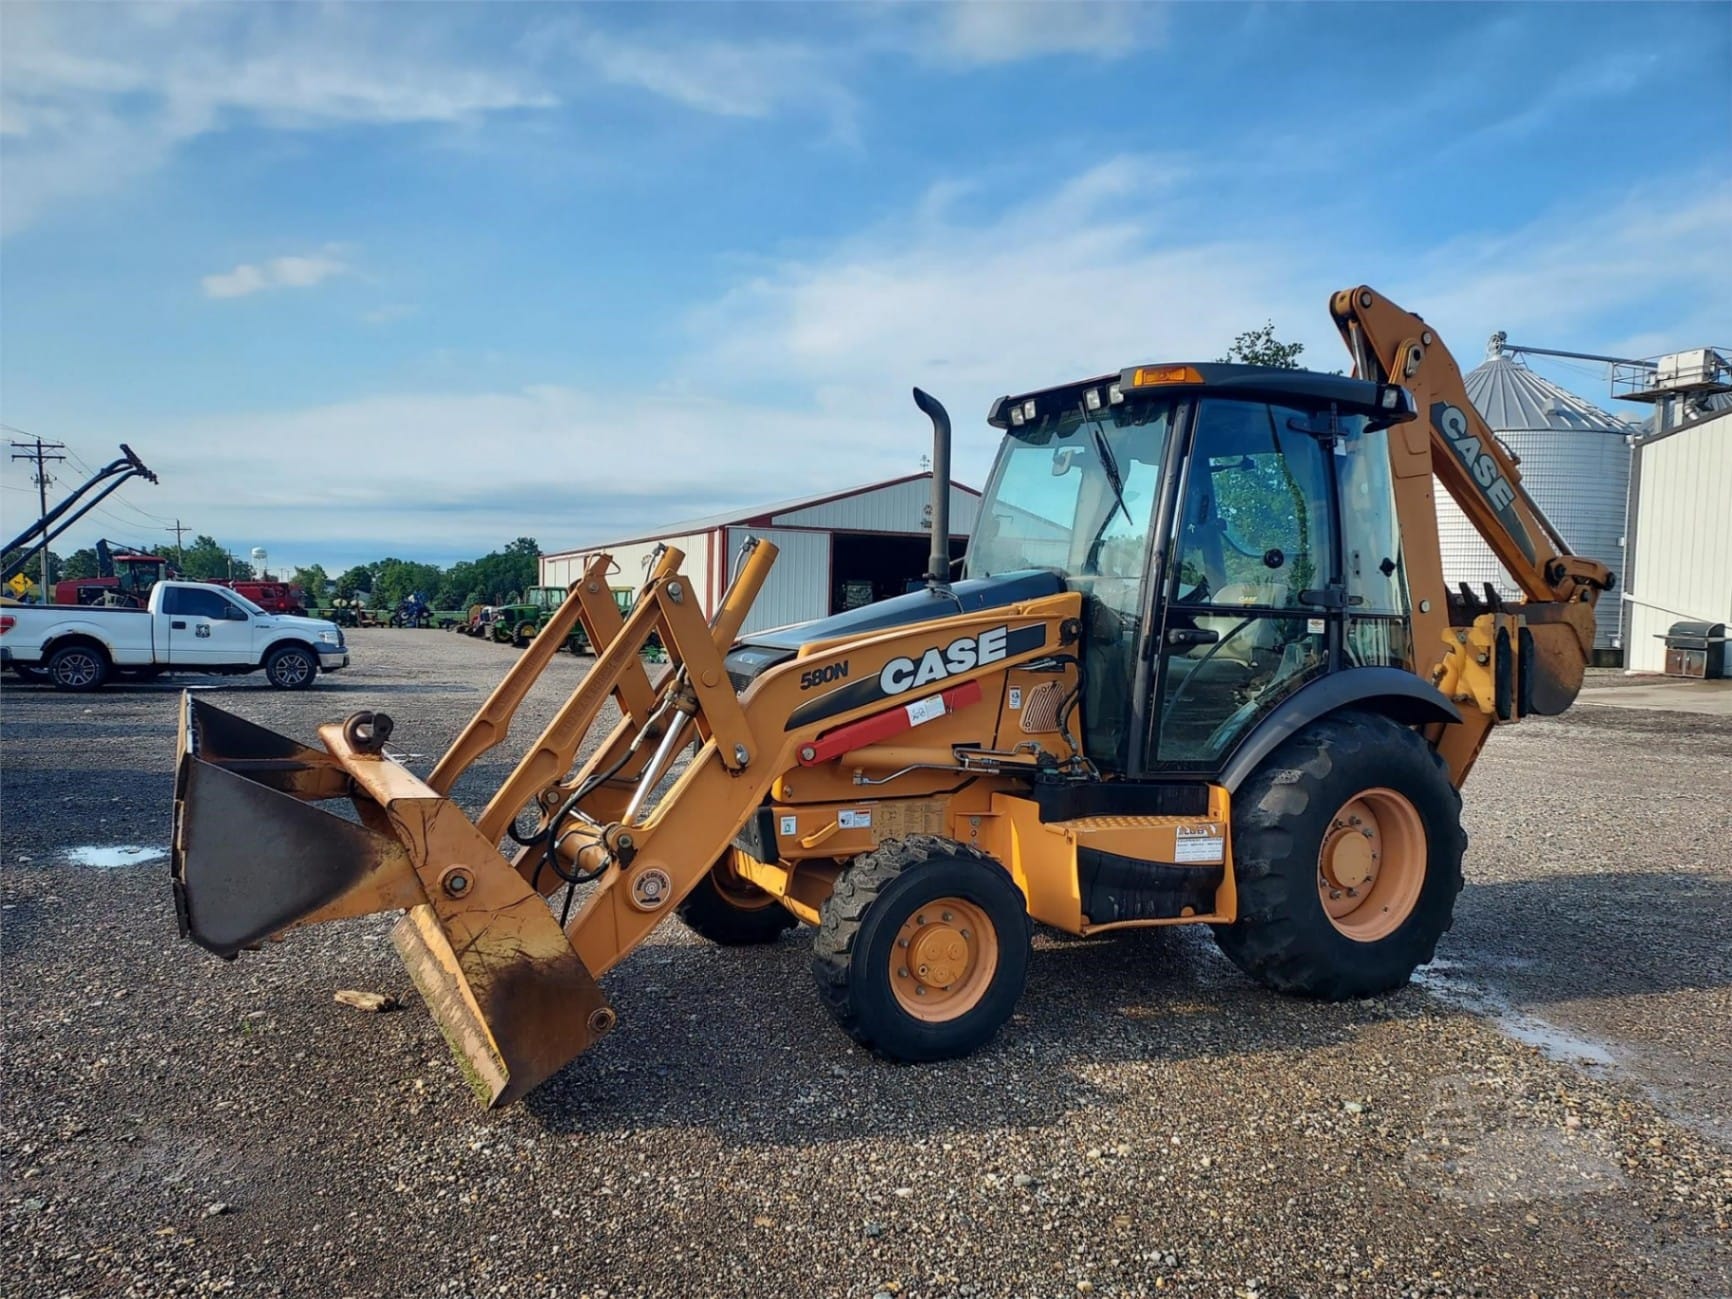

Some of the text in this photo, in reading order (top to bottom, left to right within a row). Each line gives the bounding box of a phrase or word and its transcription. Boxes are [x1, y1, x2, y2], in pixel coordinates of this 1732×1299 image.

[1441, 406, 1516, 512] CASE
[800, 660, 848, 690] 580N
[880, 626, 1007, 695] CASE
